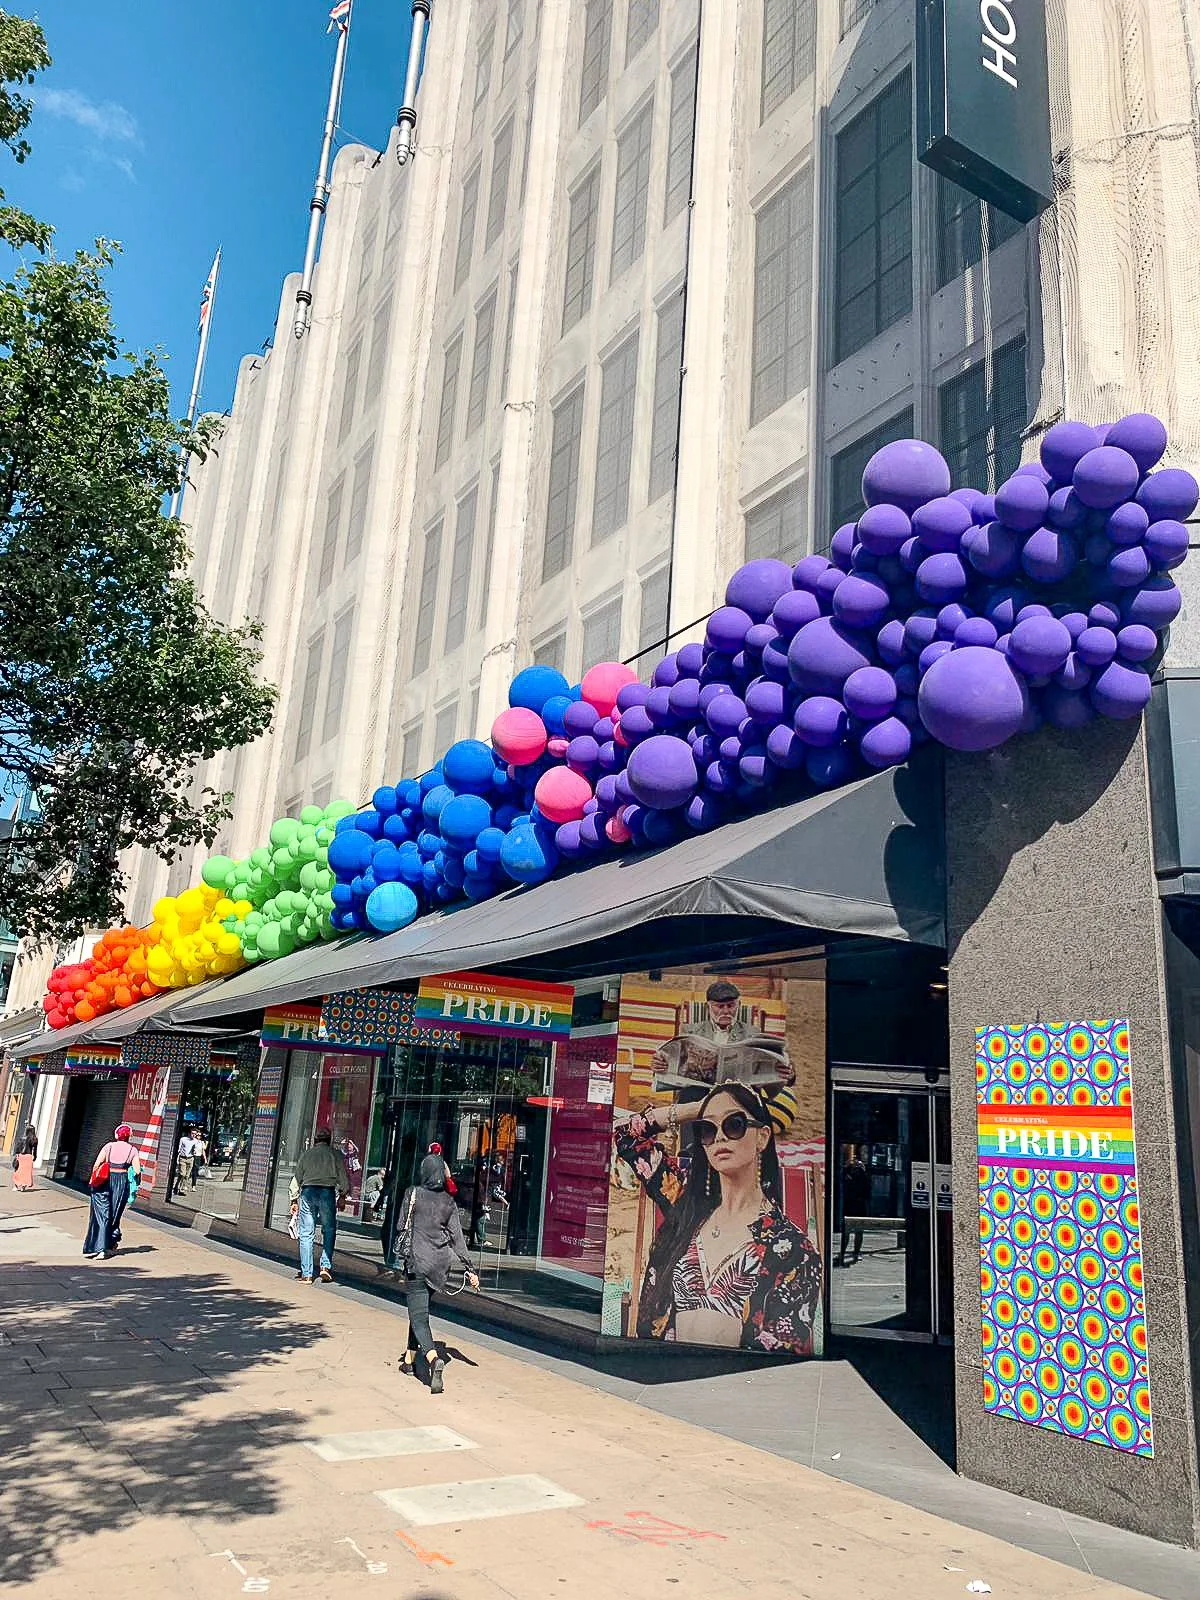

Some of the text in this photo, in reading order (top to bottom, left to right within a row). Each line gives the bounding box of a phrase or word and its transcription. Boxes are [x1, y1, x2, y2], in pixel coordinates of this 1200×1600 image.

[981, 0, 1018, 88] HO
[442, 981, 497, 993] CELEBRATING
[440, 991, 552, 1028] PRIDE
[129, 1072, 152, 1100] SALE
[996, 1127, 1115, 1161] PRIDE
